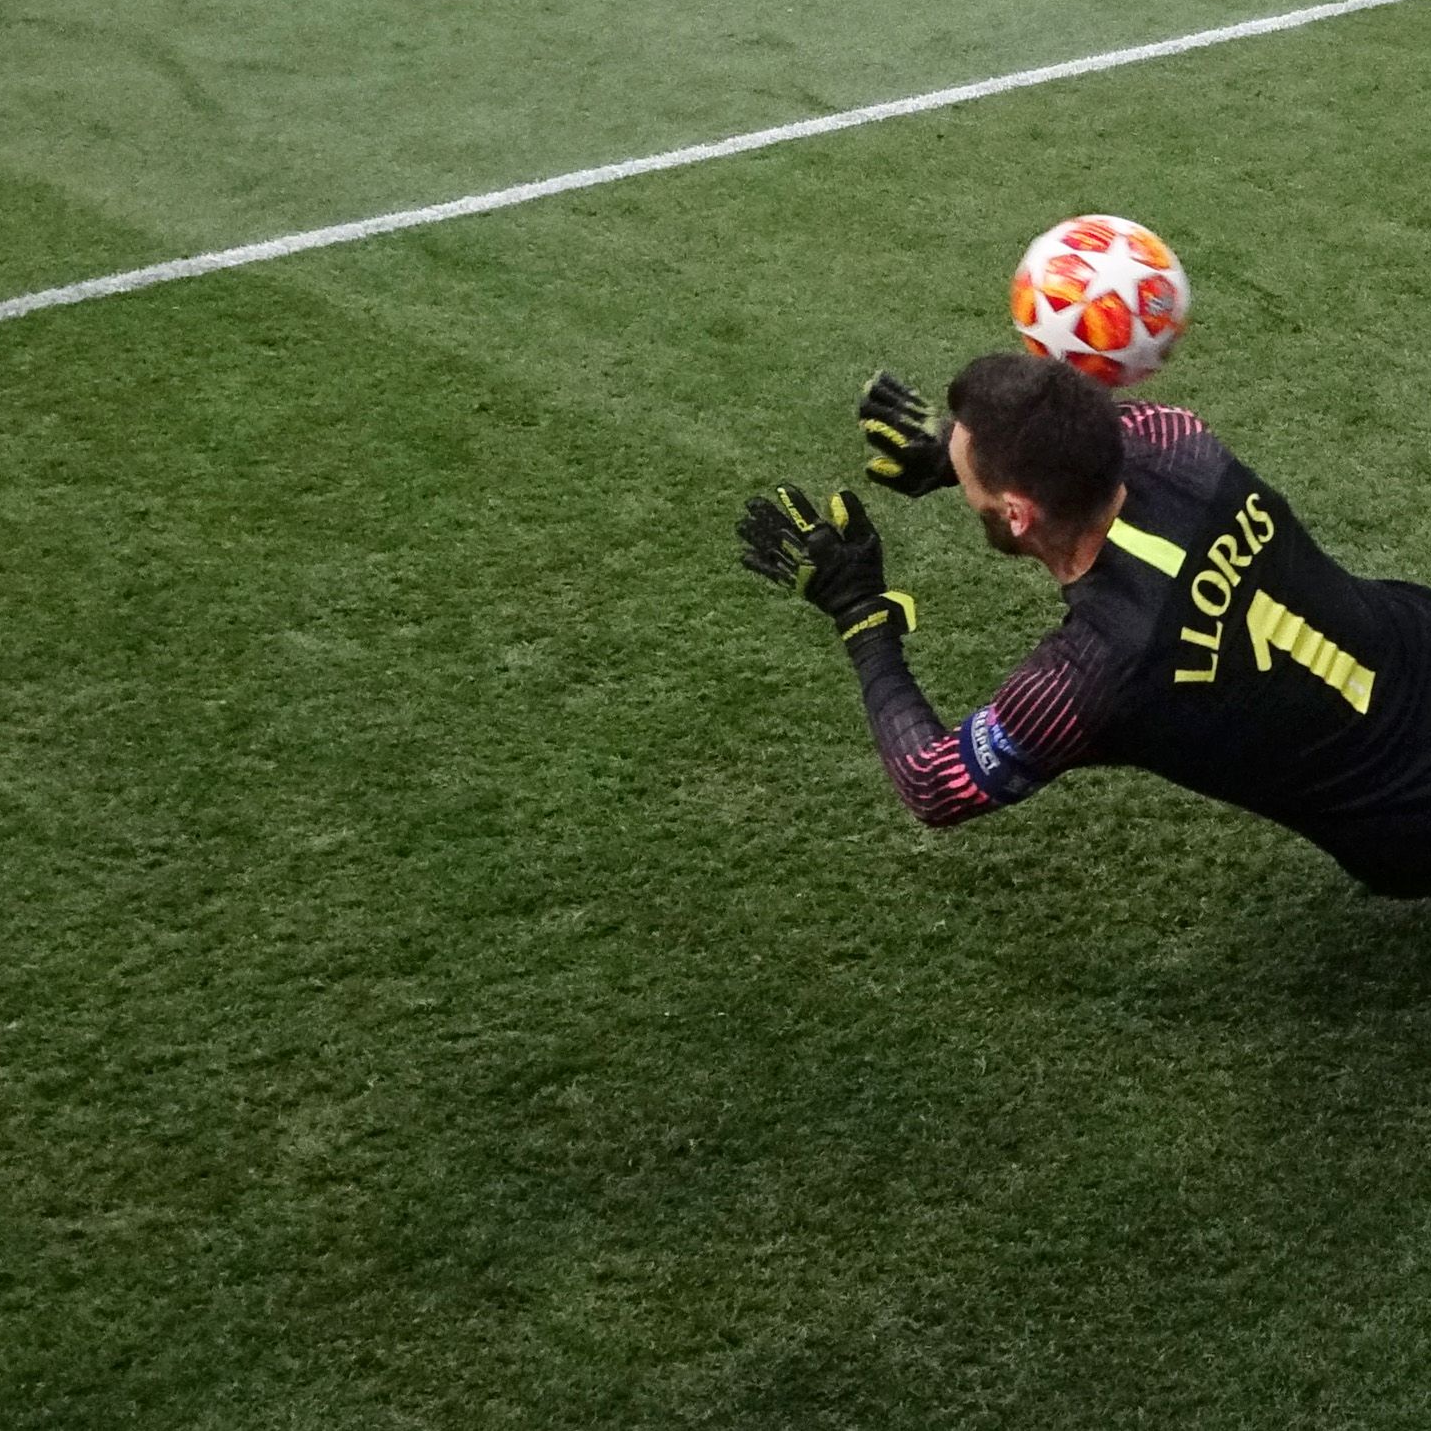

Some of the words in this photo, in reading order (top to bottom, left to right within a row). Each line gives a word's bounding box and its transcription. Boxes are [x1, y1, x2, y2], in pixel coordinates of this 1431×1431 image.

[1174, 492, 1275, 683] LLORIS
[1245, 588, 1377, 715] 1
[974, 709, 1001, 770] RESPECT
